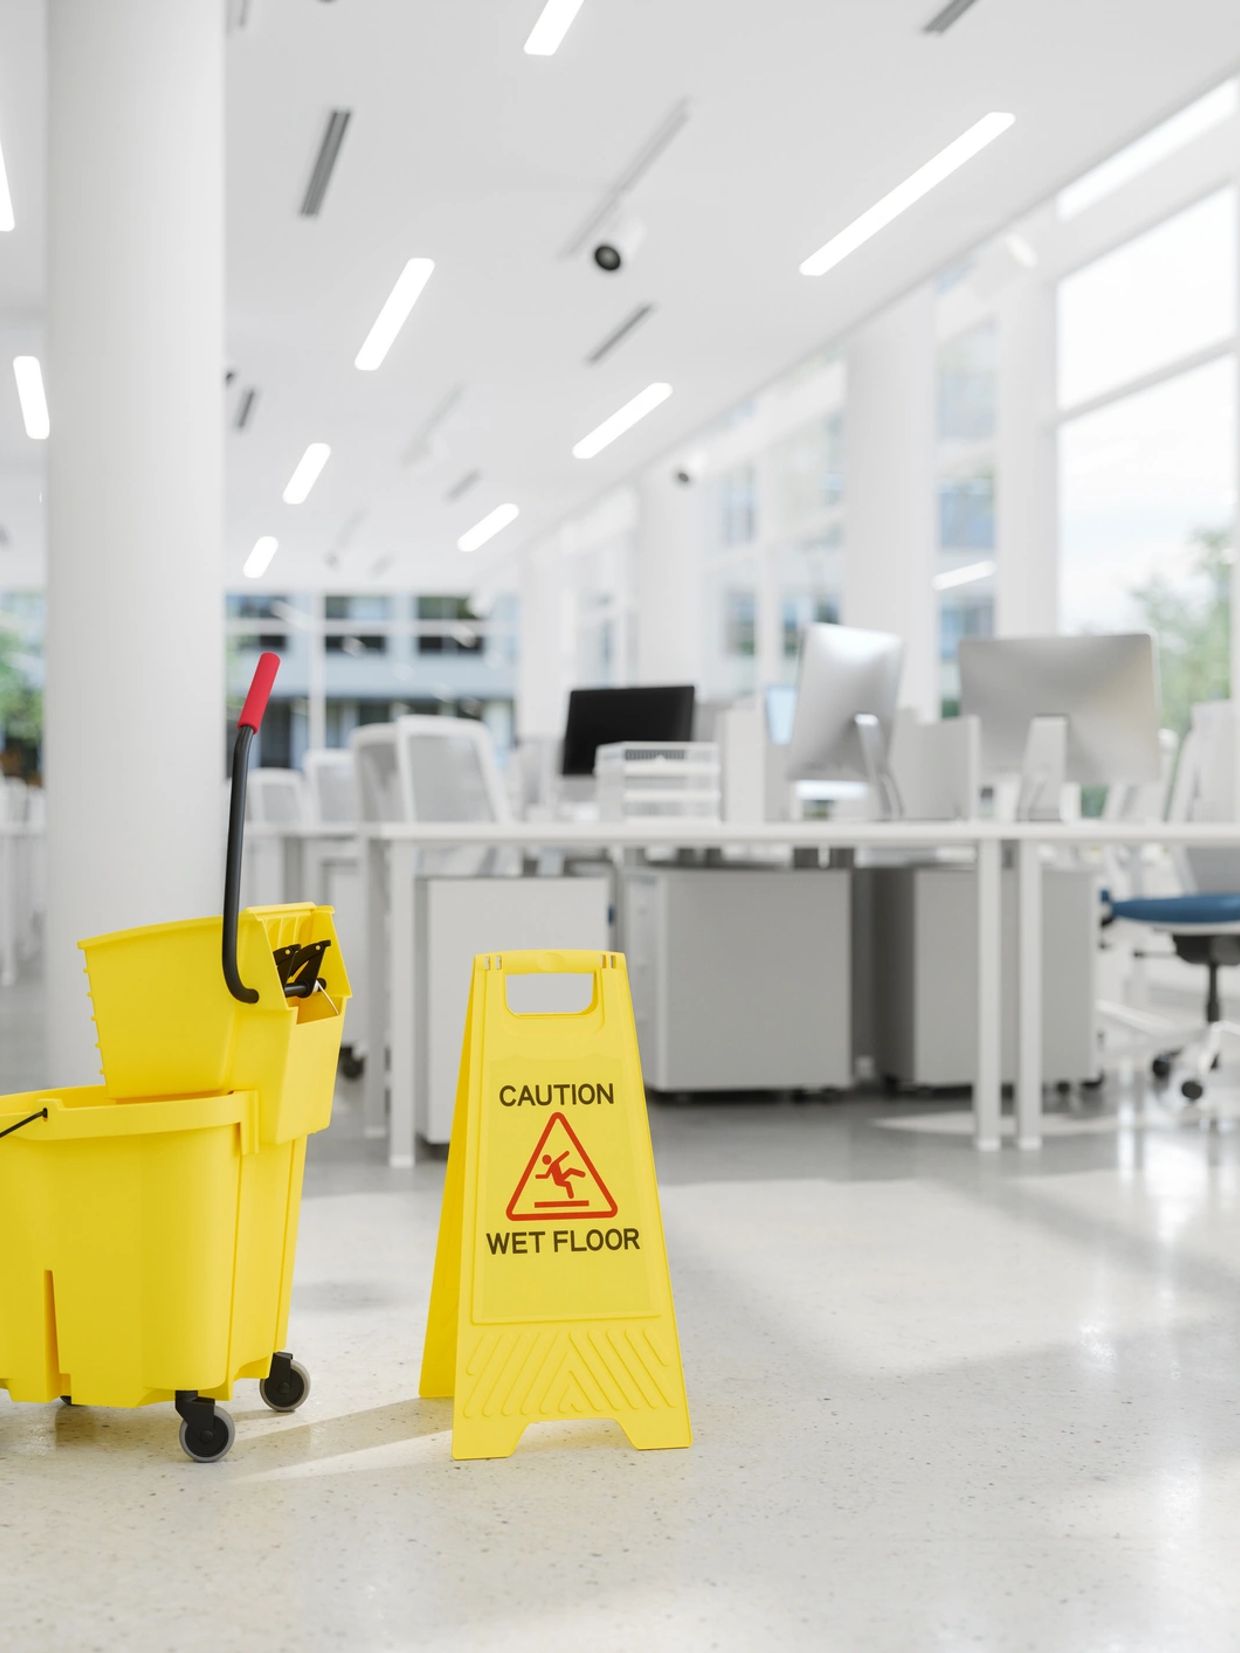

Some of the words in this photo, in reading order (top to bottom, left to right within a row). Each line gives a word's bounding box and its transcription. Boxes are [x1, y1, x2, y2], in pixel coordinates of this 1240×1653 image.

[499, 1083, 614, 1107] CAUTION
[486, 1231, 546, 1255] WET
[553, 1227, 641, 1252] FLOOR
